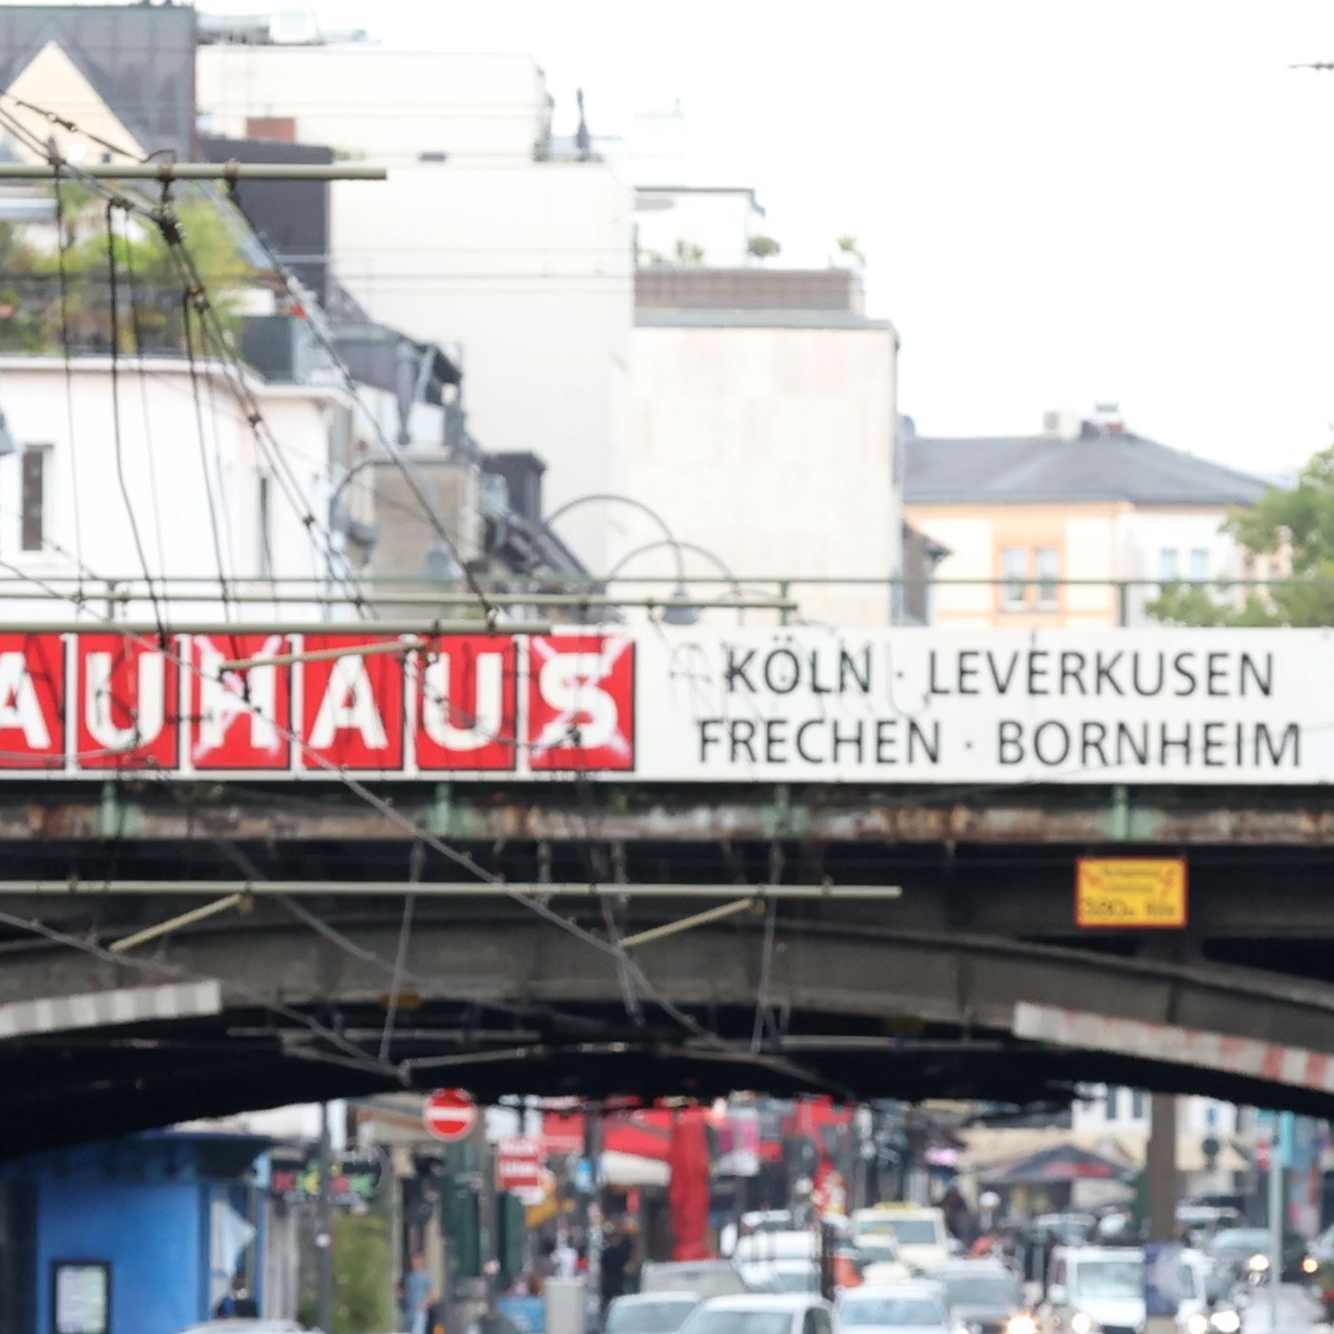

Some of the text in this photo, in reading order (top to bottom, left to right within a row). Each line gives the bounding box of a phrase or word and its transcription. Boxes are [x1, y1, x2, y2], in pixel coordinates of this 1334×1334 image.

[727, 635, 1273, 697] KÖLN LEVERKUSEN
[697, 718, 1301, 768] FRECHEN BORNHEIM
